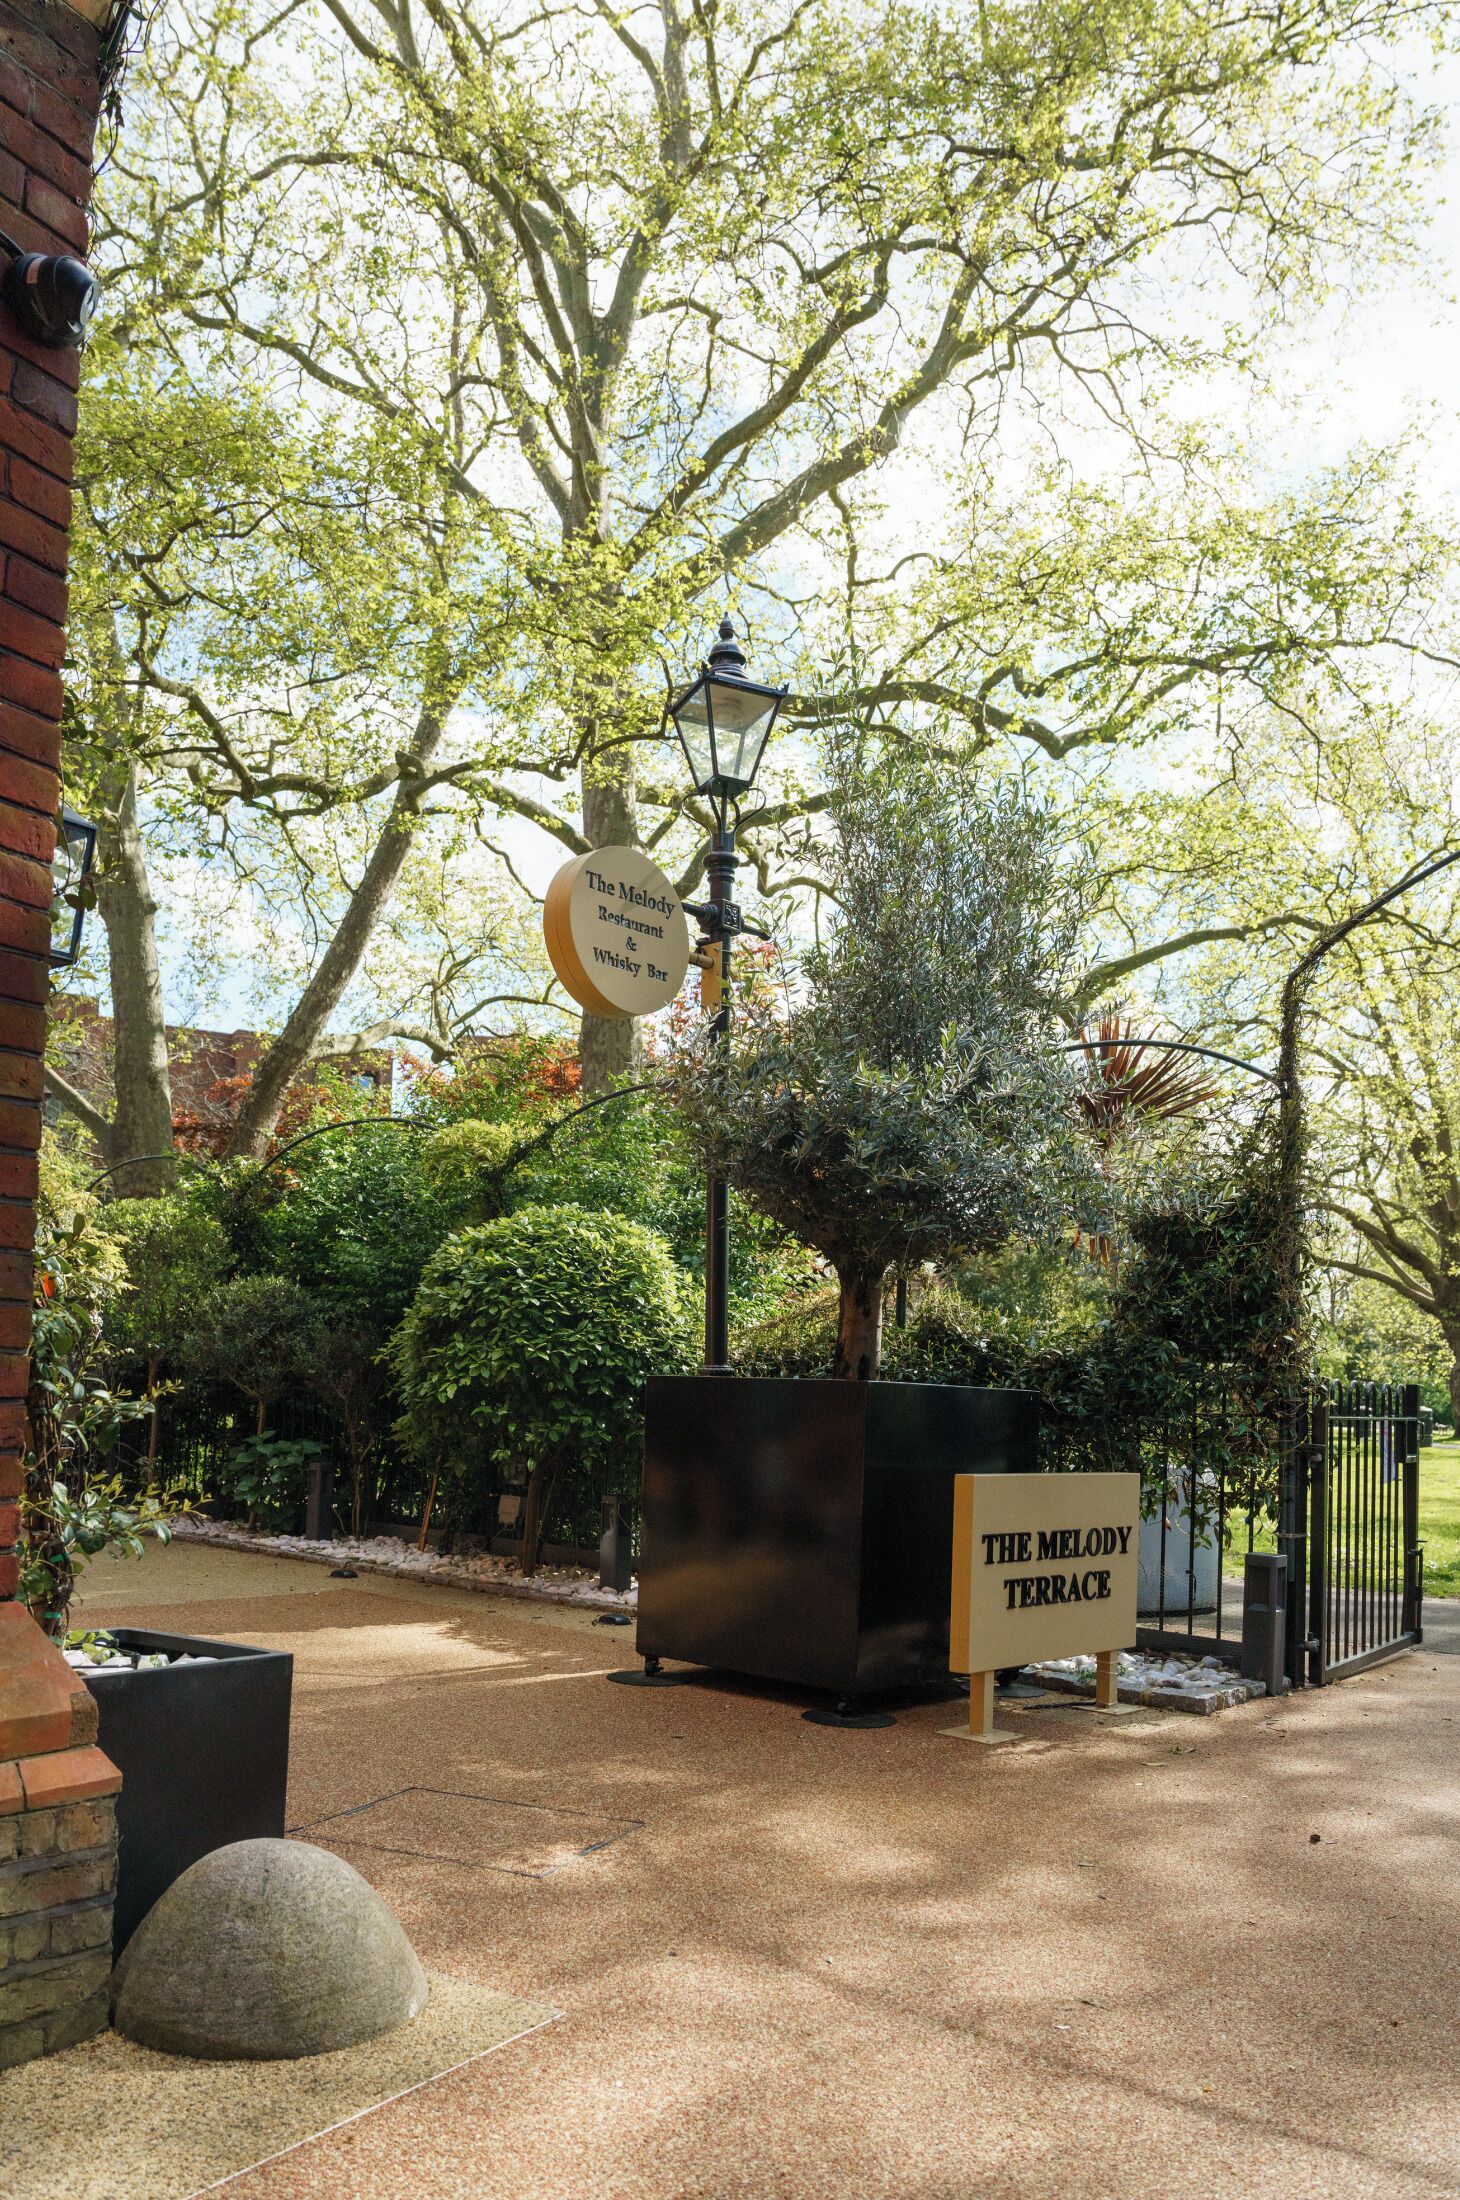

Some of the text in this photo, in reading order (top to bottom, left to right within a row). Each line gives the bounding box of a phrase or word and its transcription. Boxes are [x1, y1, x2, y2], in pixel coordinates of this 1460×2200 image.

[585, 869, 676, 919] The Melody
[598, 905, 664, 939] Restaurant
[625, 936, 637, 951] &
[592, 946, 668, 982] Whisky Bar
[981, 1525, 1133, 1565] THE MELODY
[1003, 1569, 1112, 1610] TERRACE
